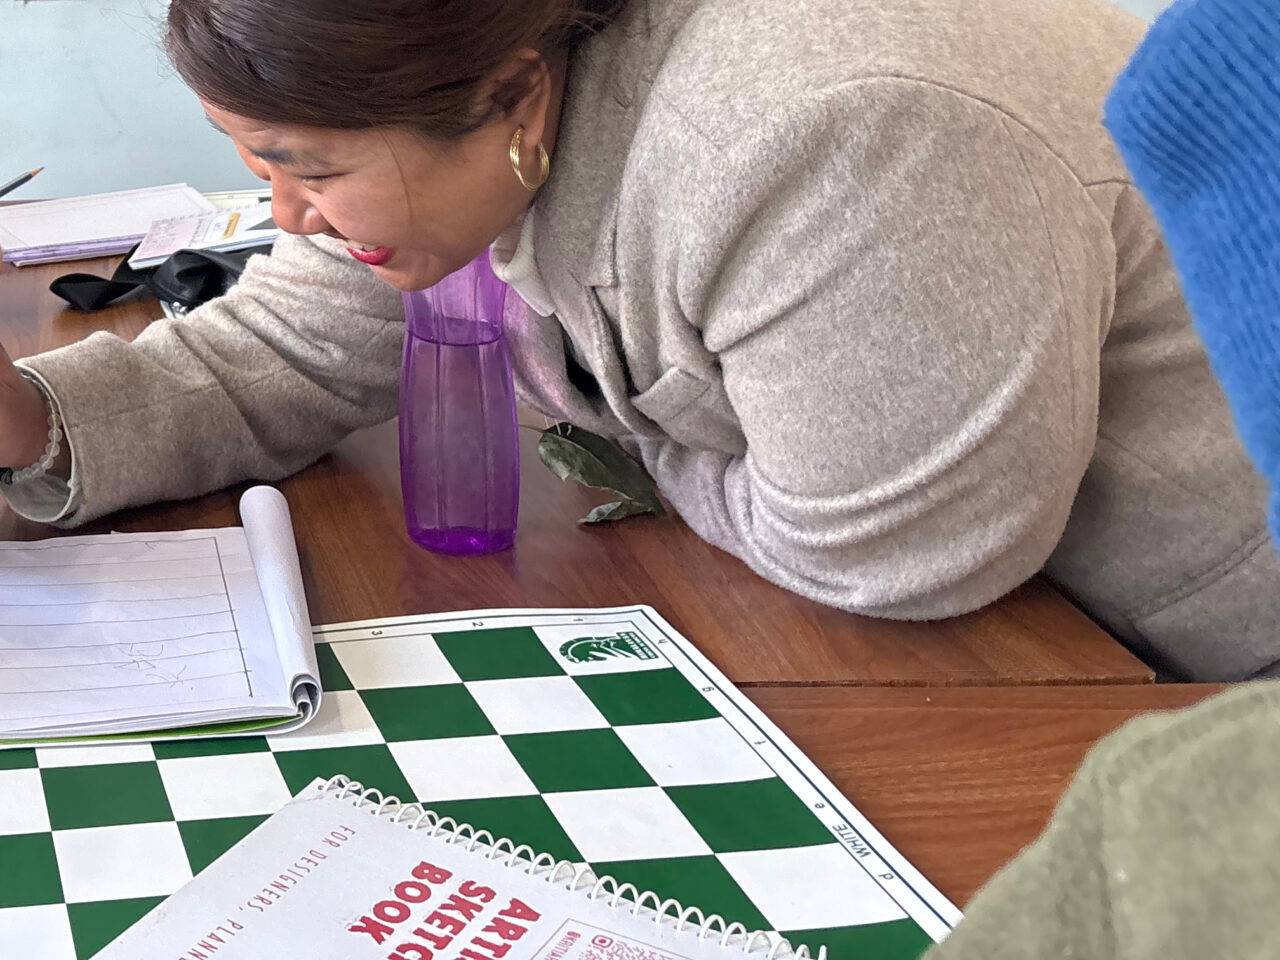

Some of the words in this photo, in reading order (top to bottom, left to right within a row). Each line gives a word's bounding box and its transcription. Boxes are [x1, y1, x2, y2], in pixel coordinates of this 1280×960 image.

[471, 620, 484, 628] 2
[814, 801, 826, 810] e
[321, 824, 356, 848] FOR
[831, 823, 872, 859] WHITE
[238, 849, 328, 912] DESIGNERS,
[346, 860, 454, 945] BOOK
[386, 880, 497, 960] SKETC
[178, 918, 245, 960] PLANN
[448, 897, 542, 960] ARTI
